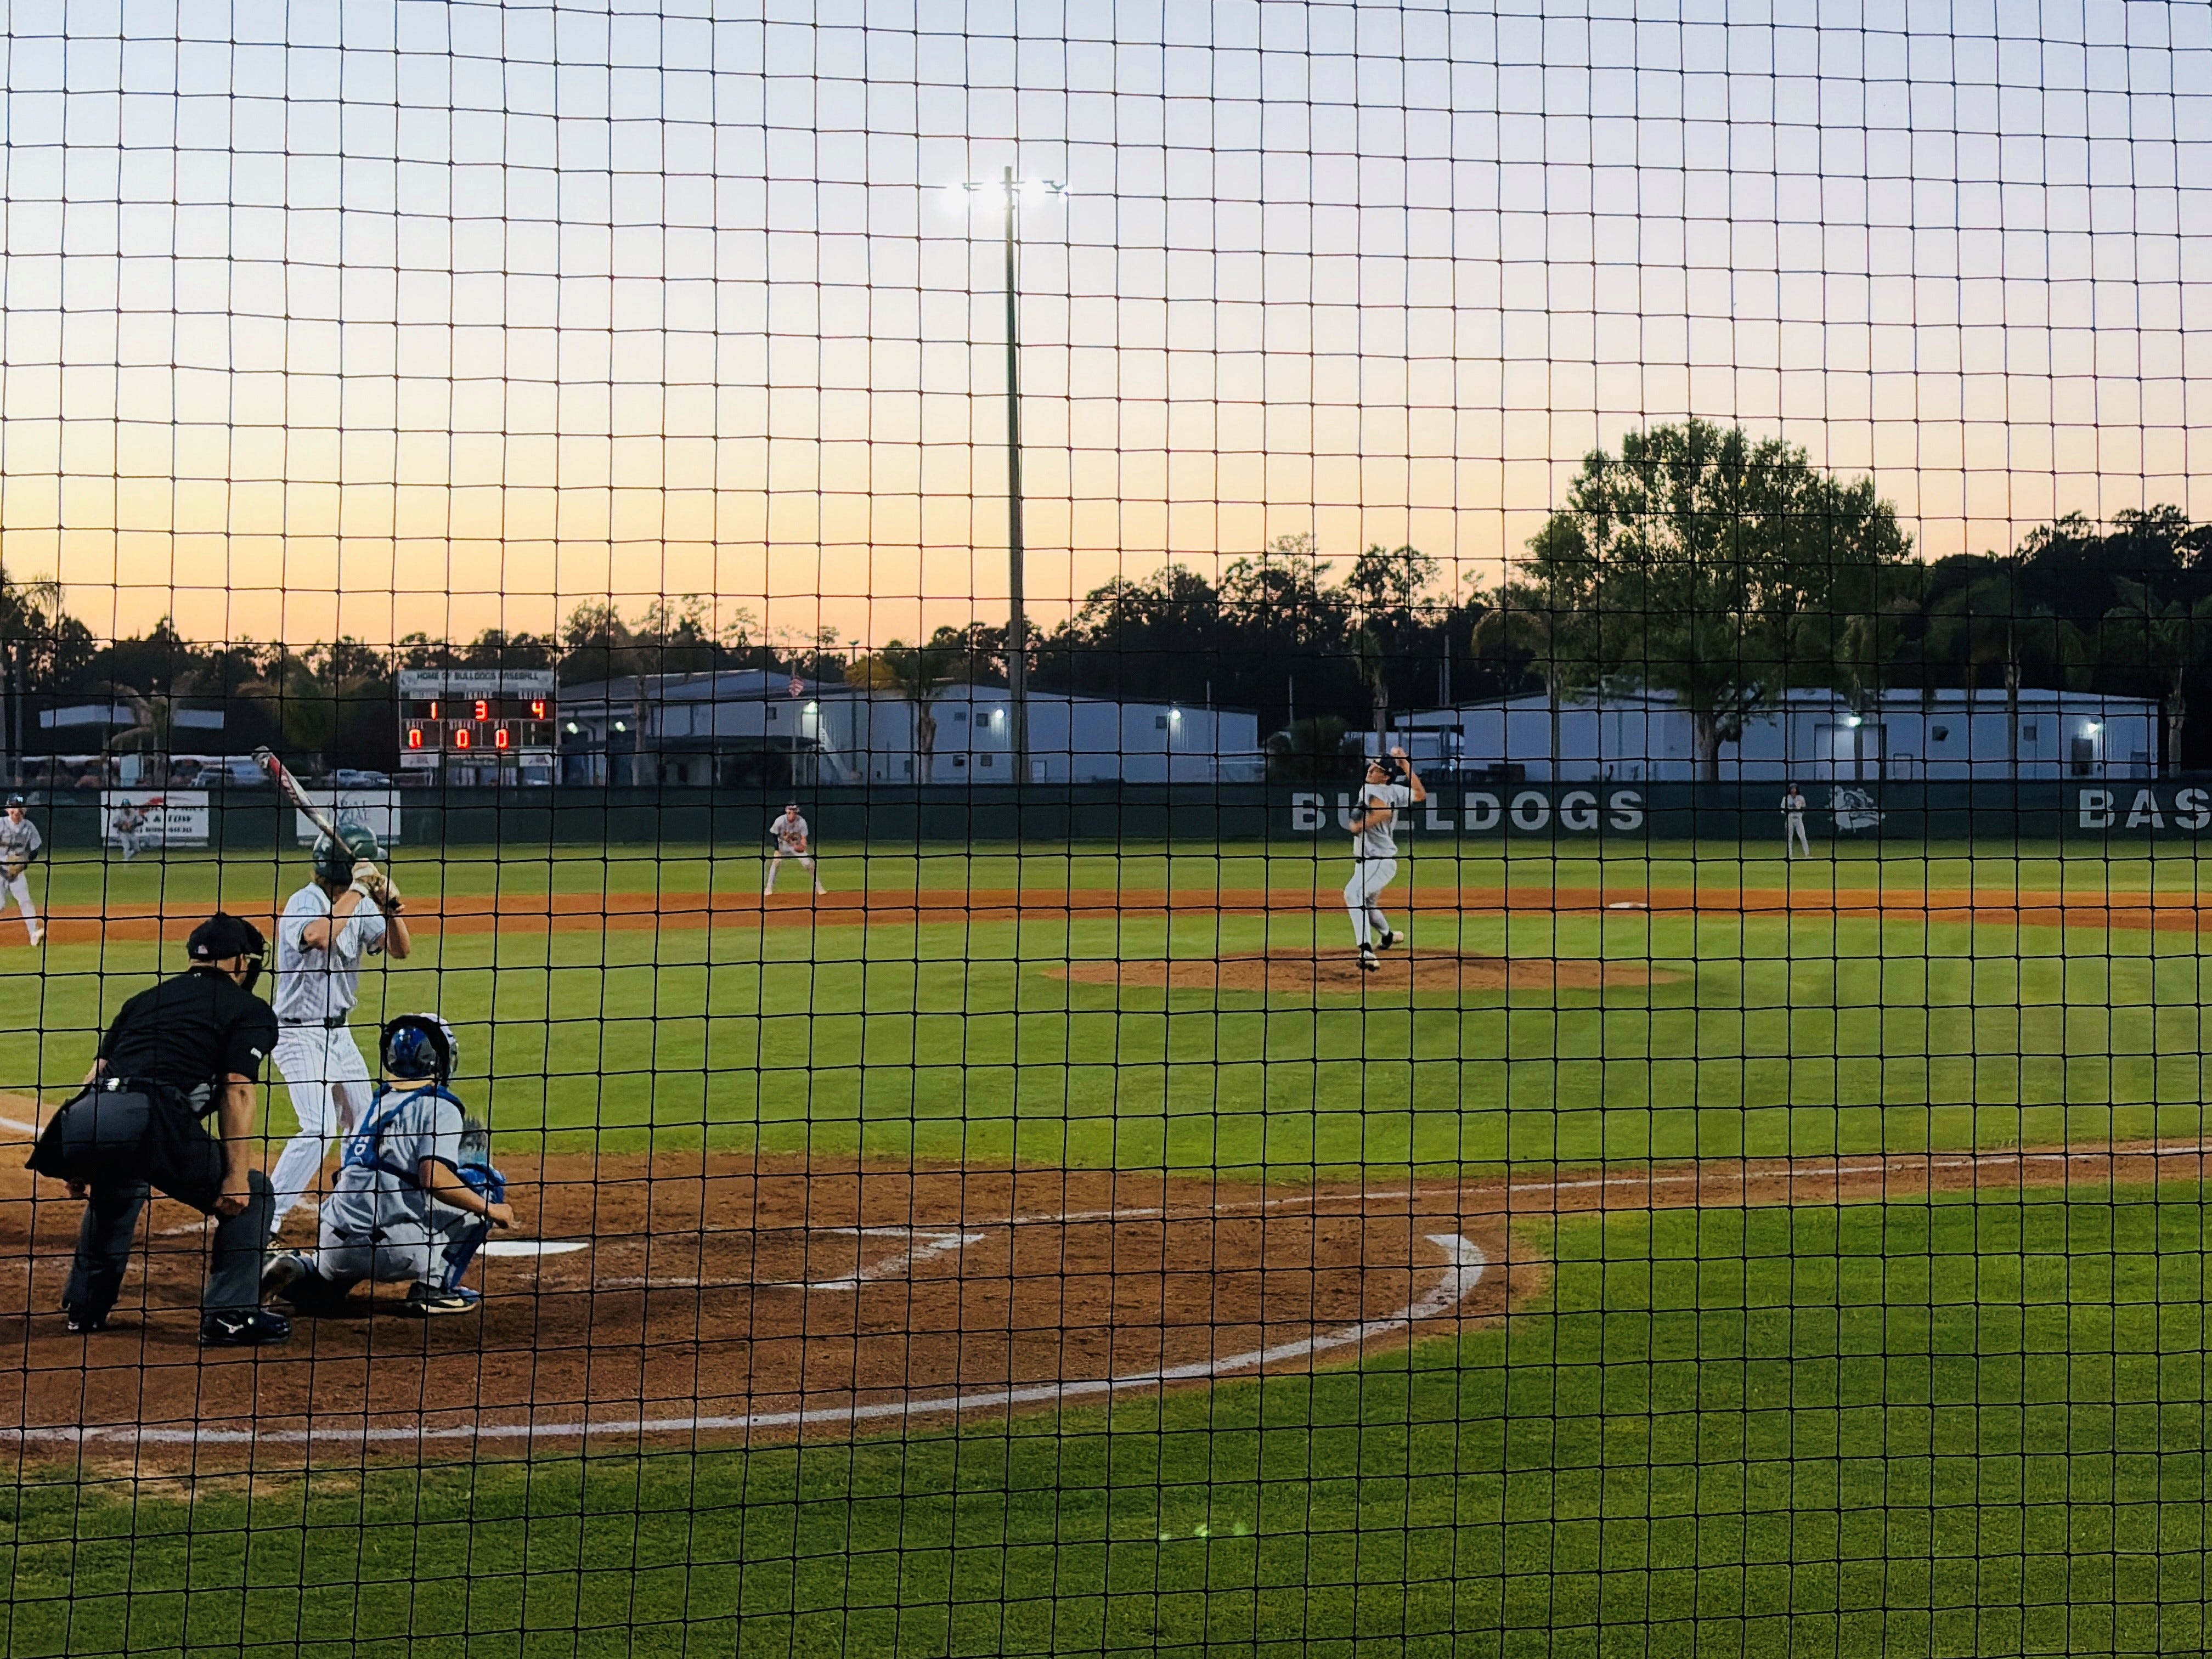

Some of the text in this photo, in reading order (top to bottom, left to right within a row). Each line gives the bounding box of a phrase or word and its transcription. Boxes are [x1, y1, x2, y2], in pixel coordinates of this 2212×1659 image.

[454, 672, 495, 680] BULLDOGS
[498, 672, 538, 680] ASEBALL
[431, 700, 545, 721] 1 3 4
[409, 728, 509, 749] 0 0 0
[1292, 790, 1644, 831] BULDOGS
[2079, 788, 2211, 830] BAS
